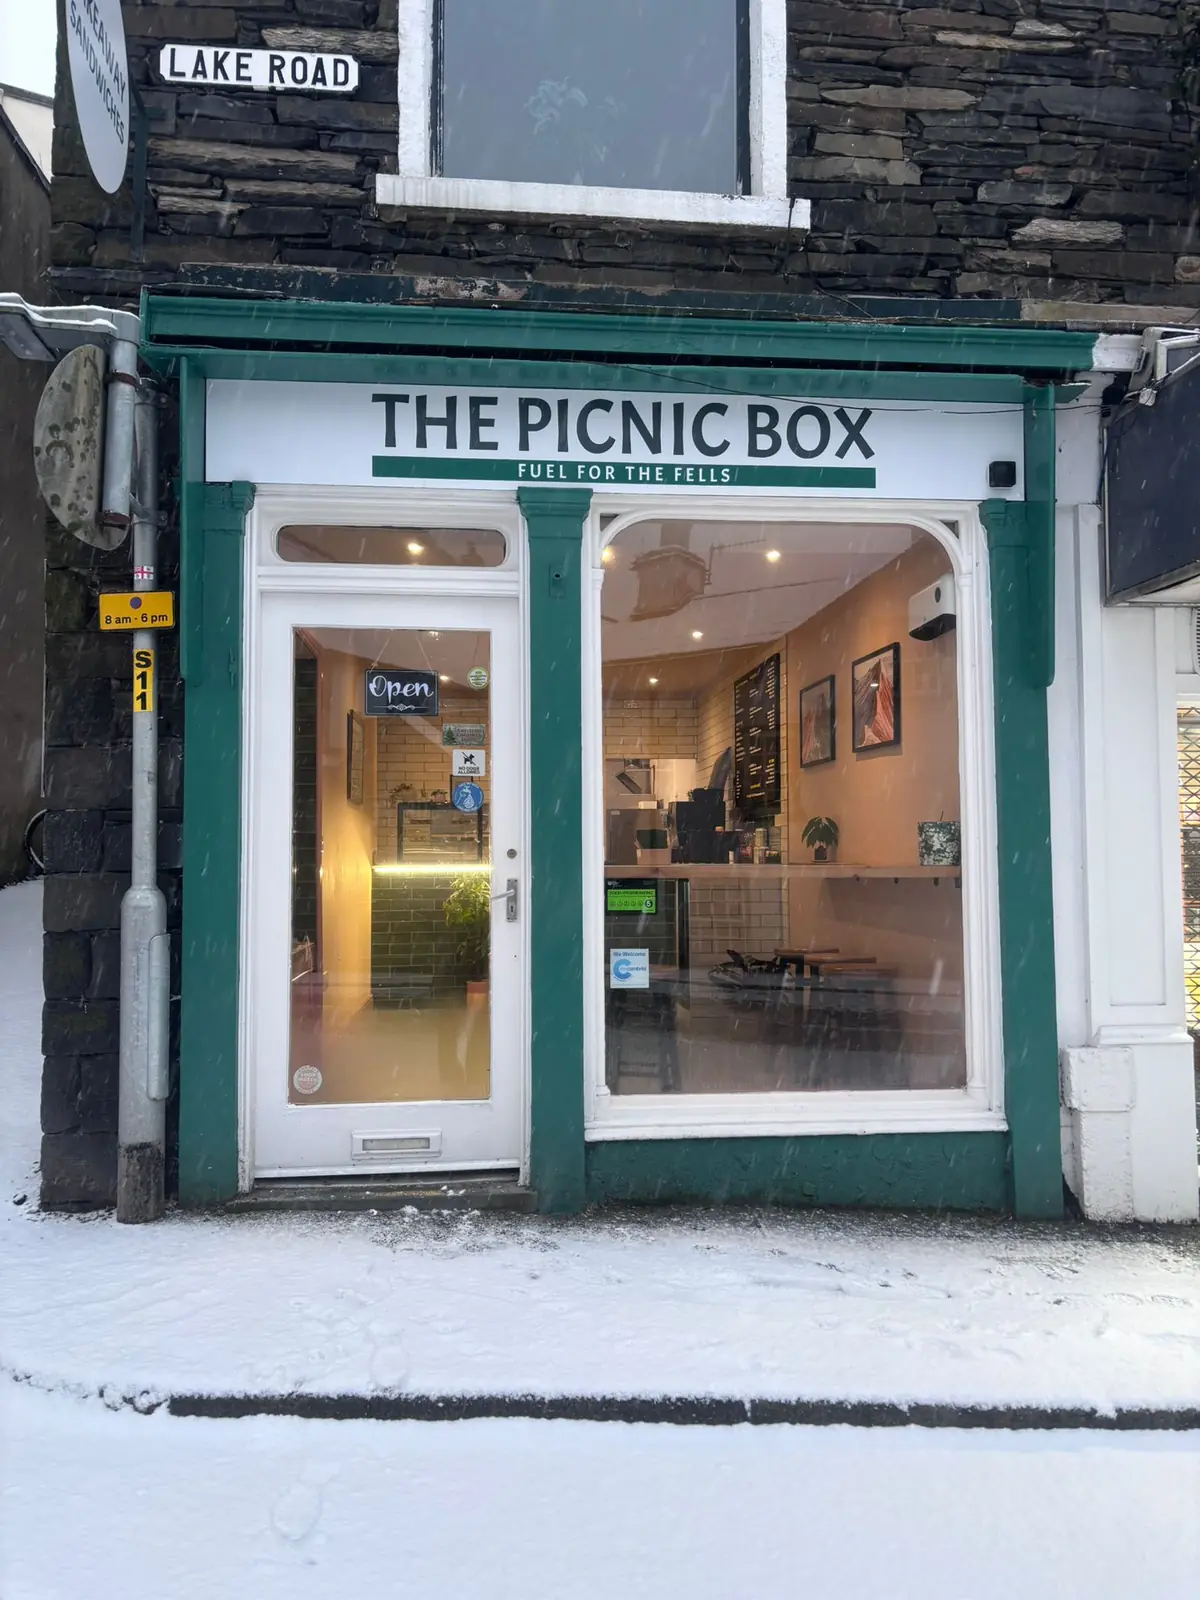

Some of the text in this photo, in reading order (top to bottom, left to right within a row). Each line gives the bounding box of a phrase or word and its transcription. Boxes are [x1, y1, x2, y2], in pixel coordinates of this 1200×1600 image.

[84, 0, 126, 103] KEAWAY
[169, 48, 350, 87] LAKE ROAD
[69, 0, 125, 145] SANDWICHES
[371, 393, 876, 460] THE PICNIC BOX
[517, 463, 731, 484] FUEL FOR THE FELLS
[104, 614, 112, 625] 8
[115, 616, 132, 624] am
[141, 613, 148, 623] 6
[150, 614, 168, 624] pm
[369, 675, 435, 704] Open
